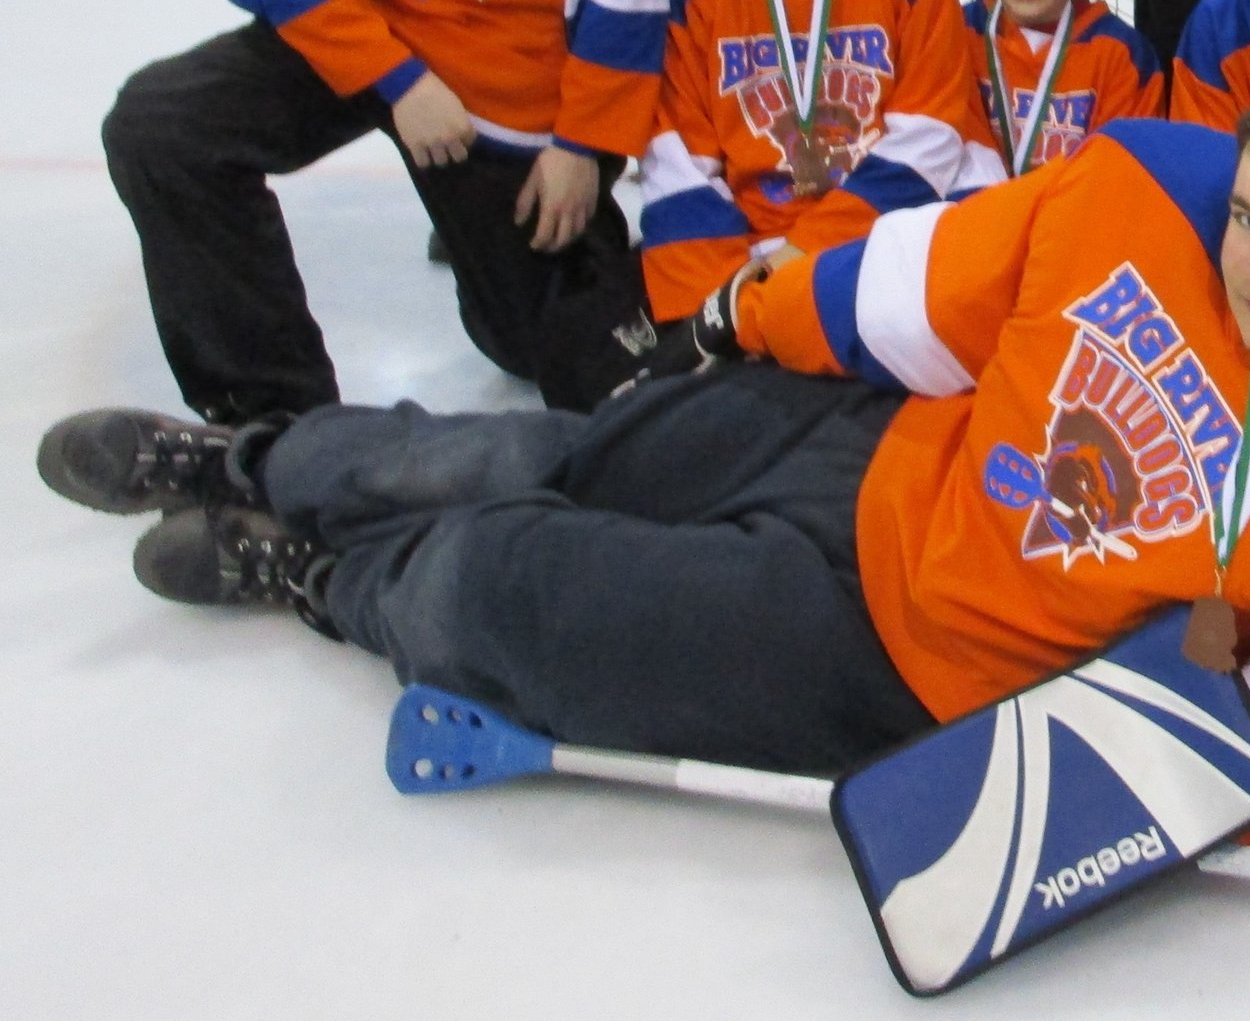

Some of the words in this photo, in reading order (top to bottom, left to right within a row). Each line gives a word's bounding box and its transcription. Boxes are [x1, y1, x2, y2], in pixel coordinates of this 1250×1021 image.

[718, 34, 781, 96] BIG
[1063, 261, 1184, 372] BIG
[1051, 332, 1205, 540] BULLDOGS
[1034, 826, 1167, 911] Reebok
